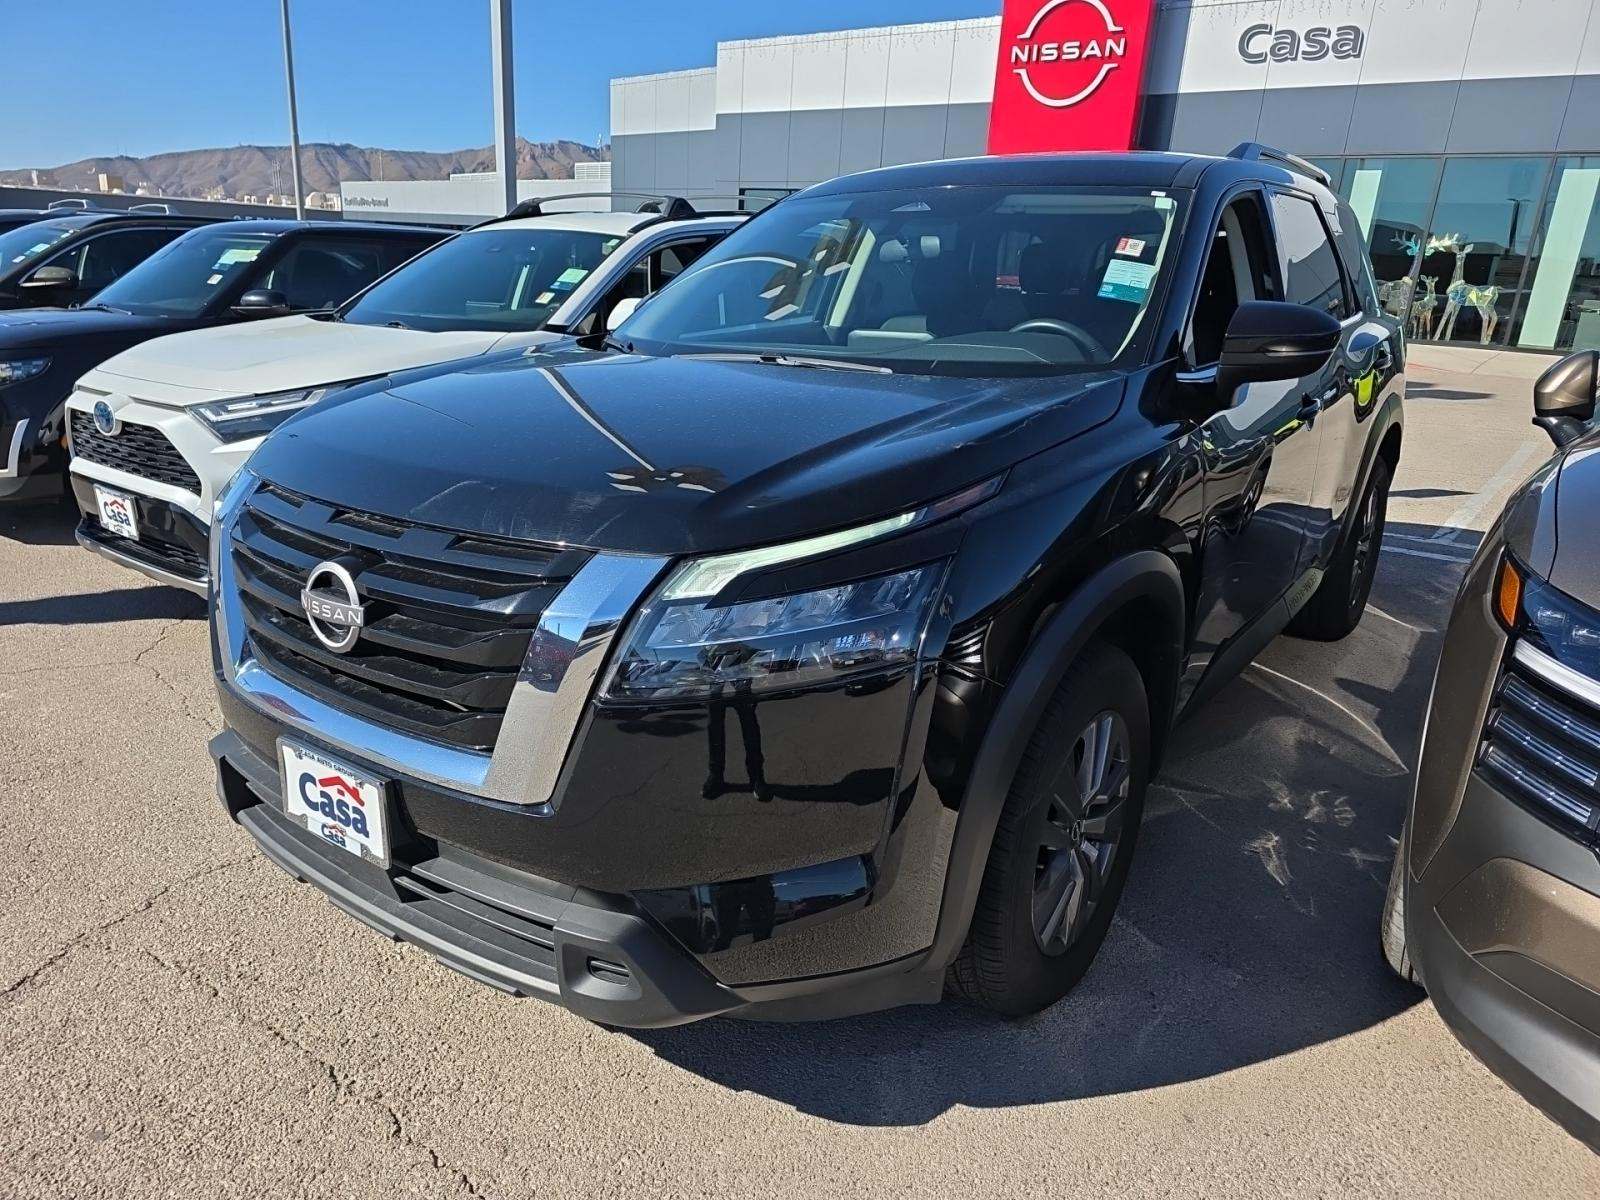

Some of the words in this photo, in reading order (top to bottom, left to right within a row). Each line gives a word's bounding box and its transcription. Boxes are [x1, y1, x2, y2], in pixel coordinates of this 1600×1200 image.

[1010, 37, 1126, 63] NISSAN
[1238, 23, 1364, 64] Casa
[104, 501, 131, 527] Casa
[302, 597, 361, 624] NISSAN
[299, 772, 370, 838] Casa
[321, 823, 346, 847] Casa
